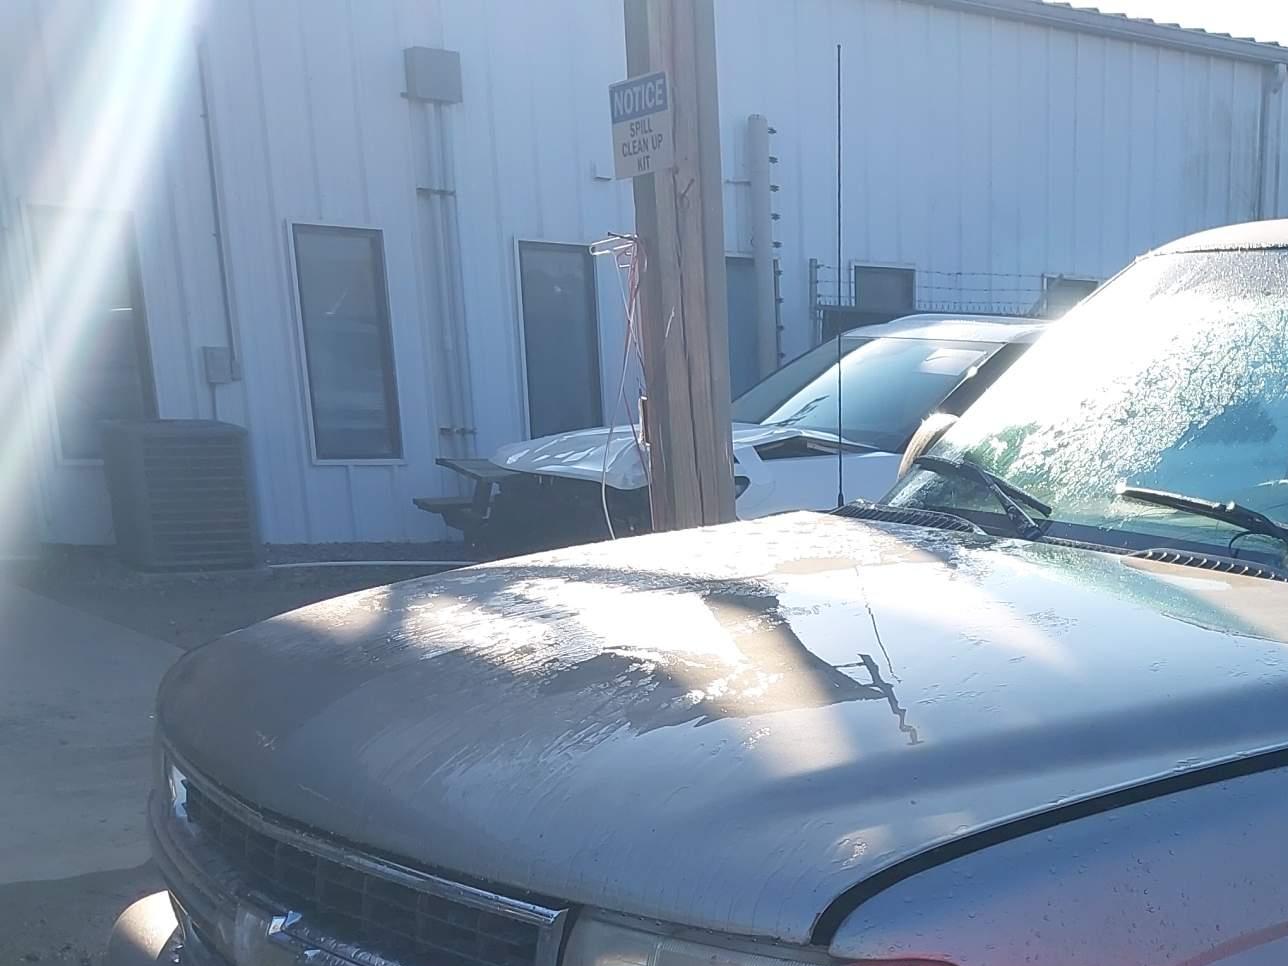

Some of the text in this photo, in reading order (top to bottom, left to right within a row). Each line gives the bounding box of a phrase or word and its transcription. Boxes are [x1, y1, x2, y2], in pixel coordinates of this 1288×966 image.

[613, 79, 664, 117] NOTICE
[630, 118, 653, 138] SPILL
[622, 134, 663, 158] CLEAN UP
[637, 156, 650, 171] KIT
